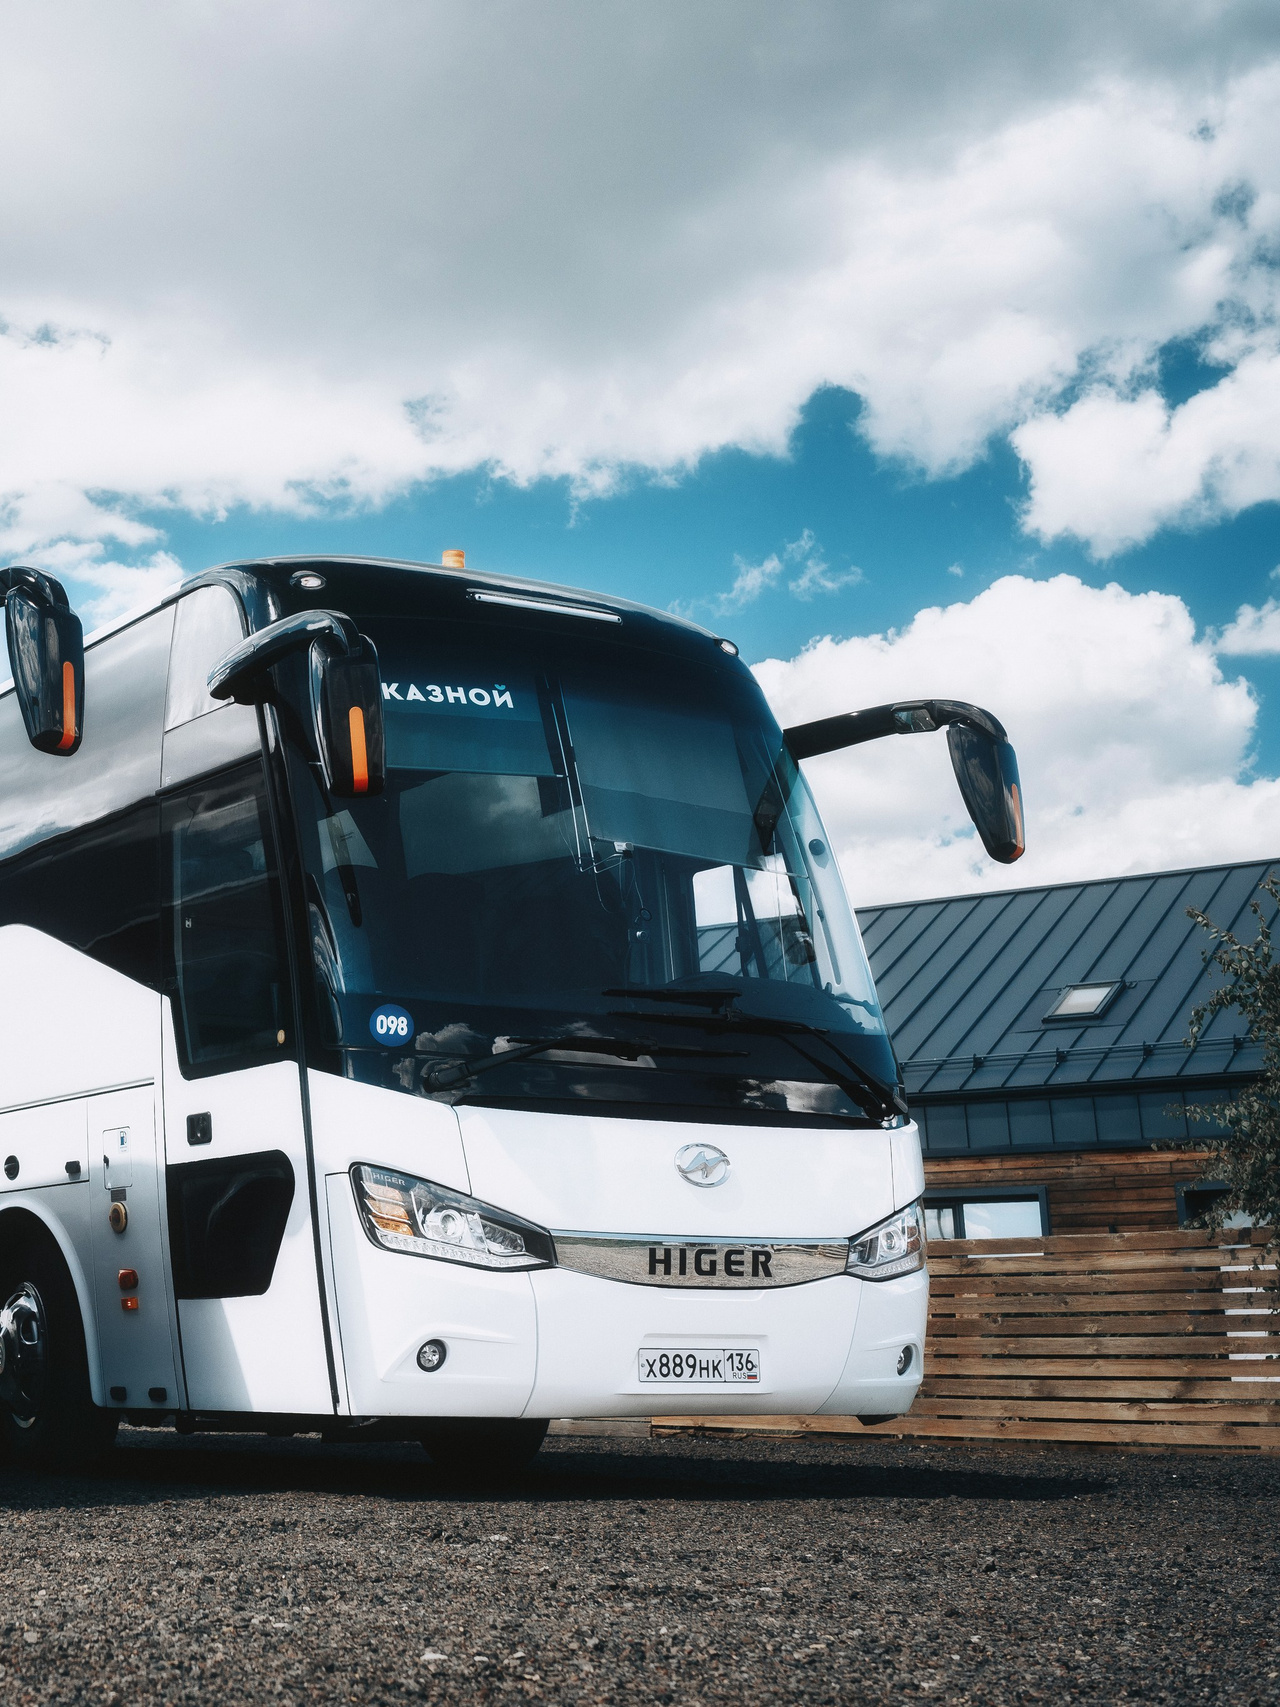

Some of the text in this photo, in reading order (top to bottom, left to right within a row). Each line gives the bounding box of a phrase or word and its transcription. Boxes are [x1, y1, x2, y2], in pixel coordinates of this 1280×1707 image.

[376, 1014, 408, 1036] 098
[648, 1247, 773, 1277] HIGER
[726, 1353, 755, 1372] 136
[732, 1372, 747, 1380] RUS
